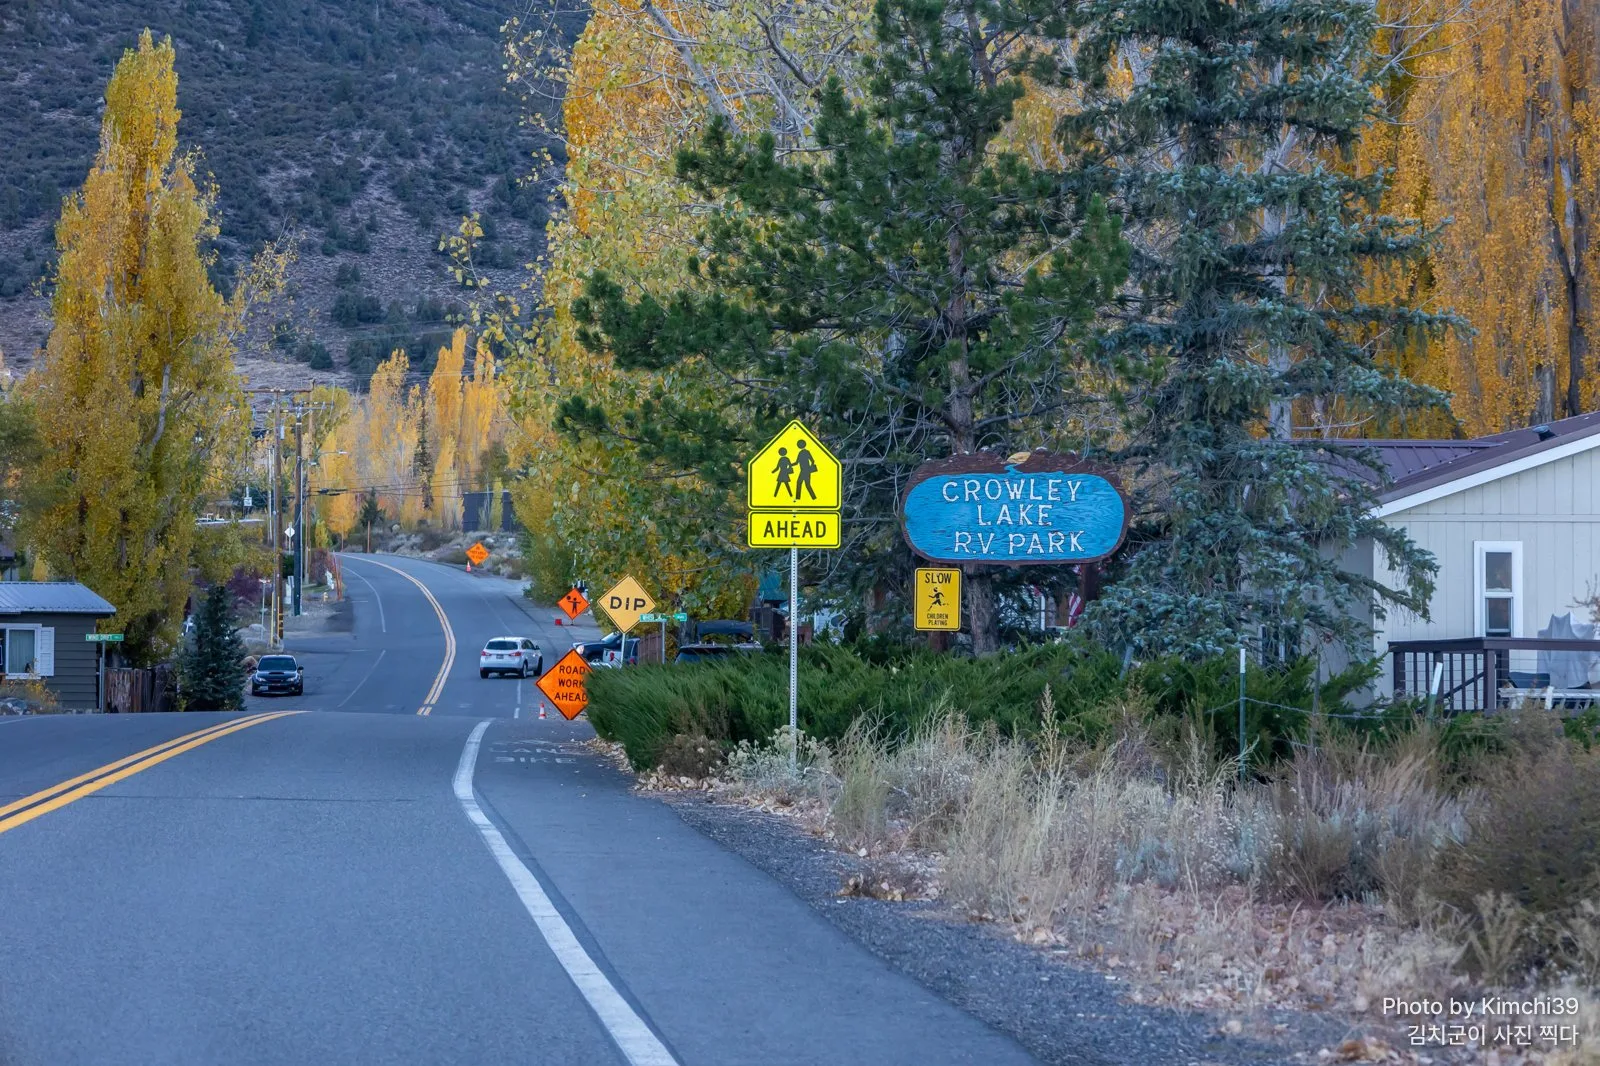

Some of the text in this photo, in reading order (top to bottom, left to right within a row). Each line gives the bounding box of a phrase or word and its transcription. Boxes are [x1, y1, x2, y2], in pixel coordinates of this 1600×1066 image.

[942, 478, 1082, 502] CROWLEY
[977, 504, 1053, 526] LAKE
[763, 520, 827, 539] AHEAD
[954, 530, 1086, 555] R.V. PARK
[924, 572, 952, 584] SLOW
[610, 596, 647, 611] DIP
[559, 665, 586, 675] ROAD
[554, 692, 588, 702] AHEAD
